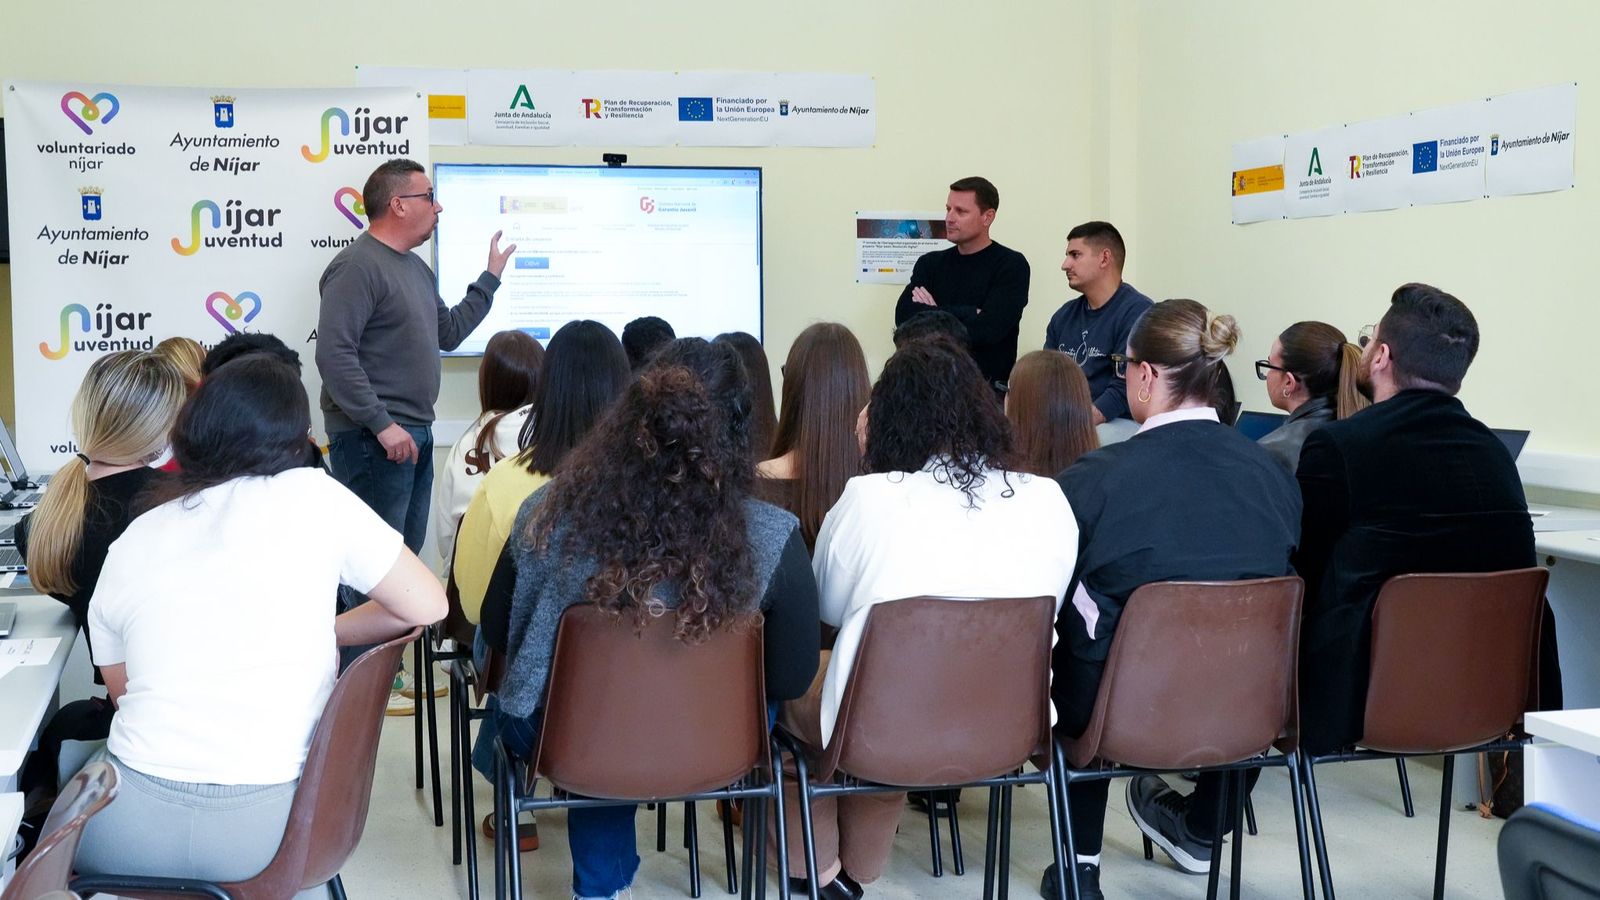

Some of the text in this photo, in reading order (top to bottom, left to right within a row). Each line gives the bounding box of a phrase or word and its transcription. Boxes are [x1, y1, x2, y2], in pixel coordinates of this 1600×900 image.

[716, 96, 754, 104] Financiado
[521, 111, 552, 119] Andalucía
[724, 105, 745, 113] Unión
[746, 106, 775, 114] Europea
[791, 105, 870, 116] Ayuntamiento de Níjar
[37, 140, 136, 155] voluntariado
[169, 131, 280, 152] Ayuntamiento
[1440, 135, 1480, 147] Financiado por
[1500, 130, 1570, 152] Ayuntamiento de Níjar
[1440, 146, 1485, 158] la Unión Europea
[69, 156, 104, 173] níjar
[189, 155, 261, 176] de Níjar
[1362, 160, 1395, 169] Transformación
[37, 225, 149, 245] Ayuntamiento
[58, 248, 129, 269] de Níjar
